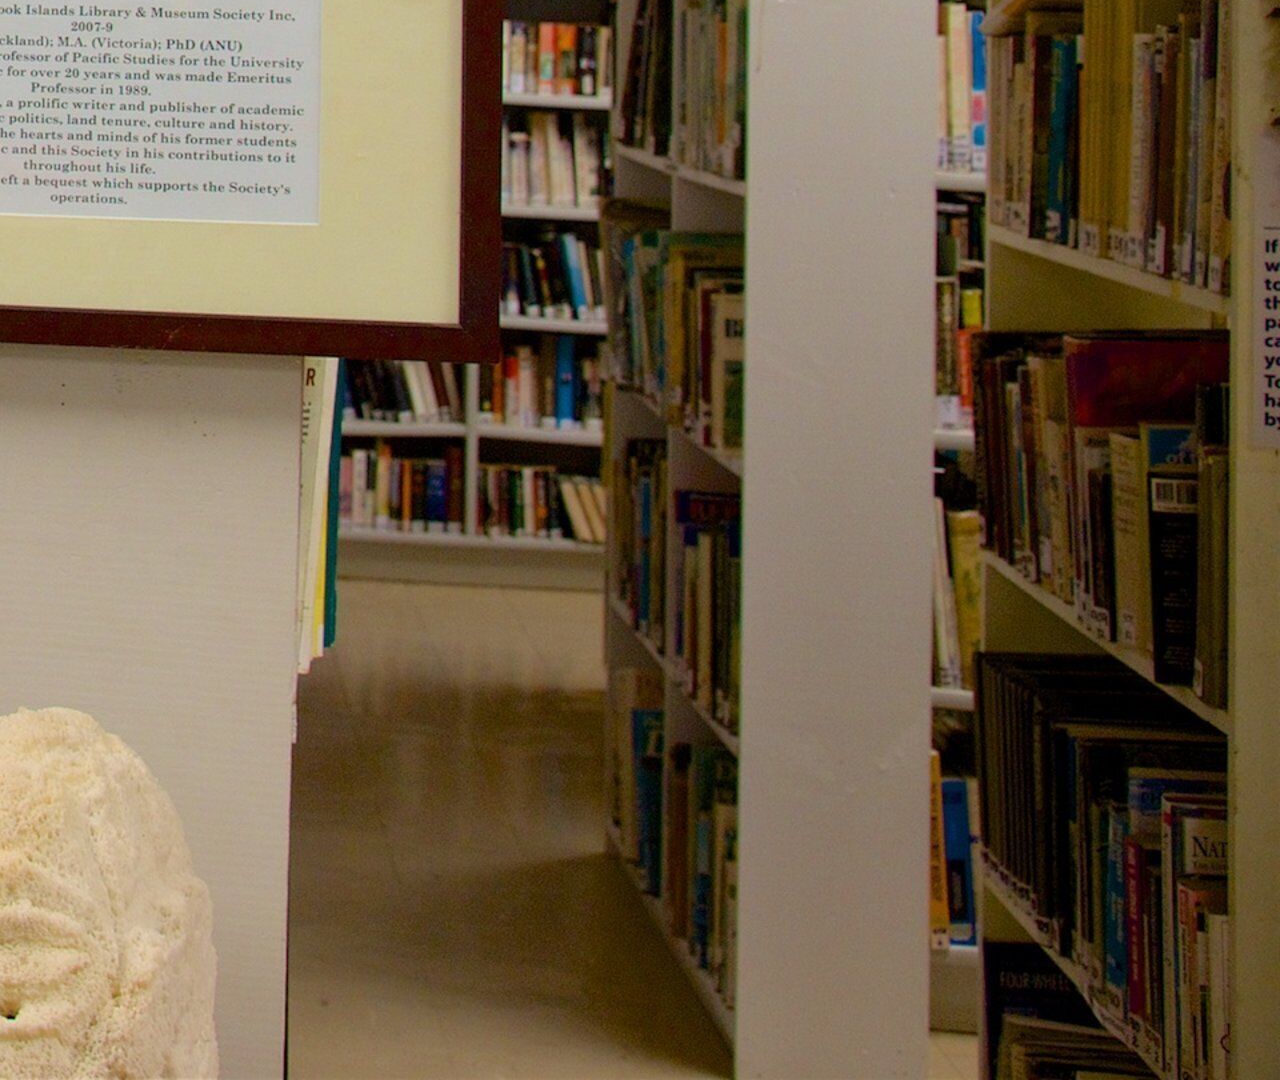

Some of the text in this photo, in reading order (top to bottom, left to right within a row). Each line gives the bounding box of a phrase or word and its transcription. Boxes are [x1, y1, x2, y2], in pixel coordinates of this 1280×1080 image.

[26, 4, 74, 15] Islands
[79, 5, 131, 19] Library
[135, 6, 146, 17] &
[150, 7, 208, 18] Museum
[212, 8, 264, 22] Society
[269, 9, 294, 21] Inc.
[70, 21, 112, 32] 2007-9
[57, 36, 86, 47] M.A.
[166, 38, 195, 50] PhD
[199, 40, 242, 52] (ANU)
[54, 51, 69, 62] of
[72, 51, 119, 63] Pacific
[122, 53, 175, 65] Studies
[179, 54, 199, 65] for
[203, 55, 225, 66] the
[230, 55, 303, 70] University
[7, 65, 26, 76] for
[30, 69, 60, 77] over
[64, 67, 79, 78] 20
[82, 71, 120, 80] years
[124, 69, 149, 80] and
[185, 71, 222, 82] made
[227, 71, 291, 83] Emeritus
[31, 81, 150, 95] Professor in 1989.
[18, 97, 68, 110] prolific
[72, 99, 115, 110] writer
[119, 100, 144, 111] and
[149, 101, 216, 113] publisher
[220, 103, 235, 113] of
[237, 104, 303, 115] academic
[9, 112, 63, 125] politics,
[67, 113, 96, 125] land
[101, 117, 150, 127] tenure,
[154, 117, 204, 128] culture
[209, 118, 235, 129] and
[240, 119, 292, 133] history.
[20, 128, 63, 140] hearts
[66, 129, 92, 140] and
[97, 131, 138, 142] minds
[142, 132, 157, 143] of
[160, 132, 180, 143] his
[185, 133, 232, 145] former
[236, 135, 296, 147] students
[11, 144, 36, 154] and
[41, 144, 66, 155] this
[70, 145, 121, 159] Society
[126, 147, 138, 157] in
[143, 147, 164, 158] his
[167, 149, 262, 161] contributions
[267, 153, 281, 162] to
[285, 152, 295, 163] it
[23, 159, 155, 174] throughout his life.
[34, 174, 86, 188] bequest
[92, 177, 132, 188] which
[137, 182, 198, 192] supports
[202, 181, 224, 192] the
[228, 181, 290, 196] Society's
[50, 193, 126, 204] operations.
